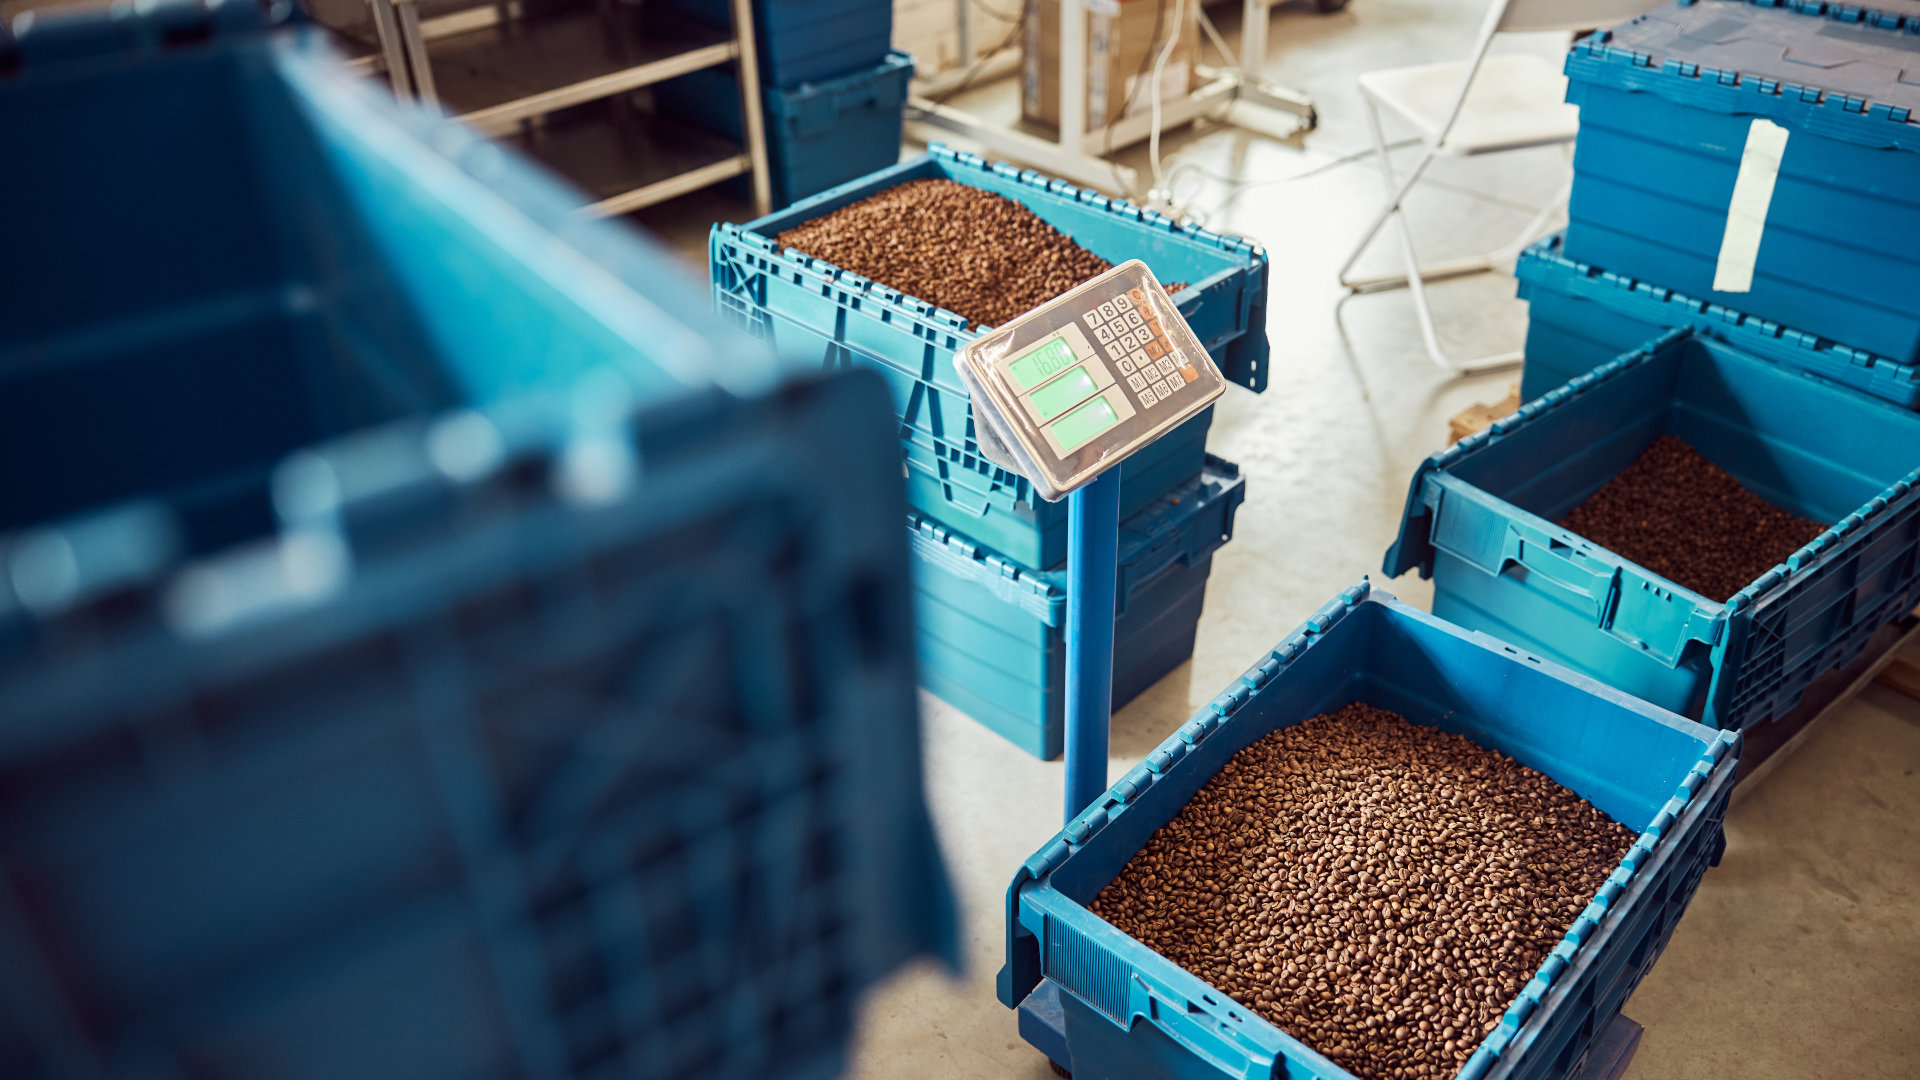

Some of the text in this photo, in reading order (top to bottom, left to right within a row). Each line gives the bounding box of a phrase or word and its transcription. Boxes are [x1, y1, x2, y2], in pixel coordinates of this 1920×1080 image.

[1087, 313, 1098, 324] 7
[1103, 306, 1113, 317] 8
[1117, 298, 1127, 309] 9
[1101, 329, 1110, 339] 4
[1113, 321, 1124, 332] 5
[1128, 313, 1139, 324] 6
[1111, 345, 1120, 355] 1
[1125, 337, 1136, 349] 2
[1139, 329, 1149, 340] 3
[1130, 376, 1144, 389] M1
[1145, 368, 1158, 381] M2
[1159, 360, 1172, 373] M3
[1141, 375, 1182, 406] M5 M6 M7
